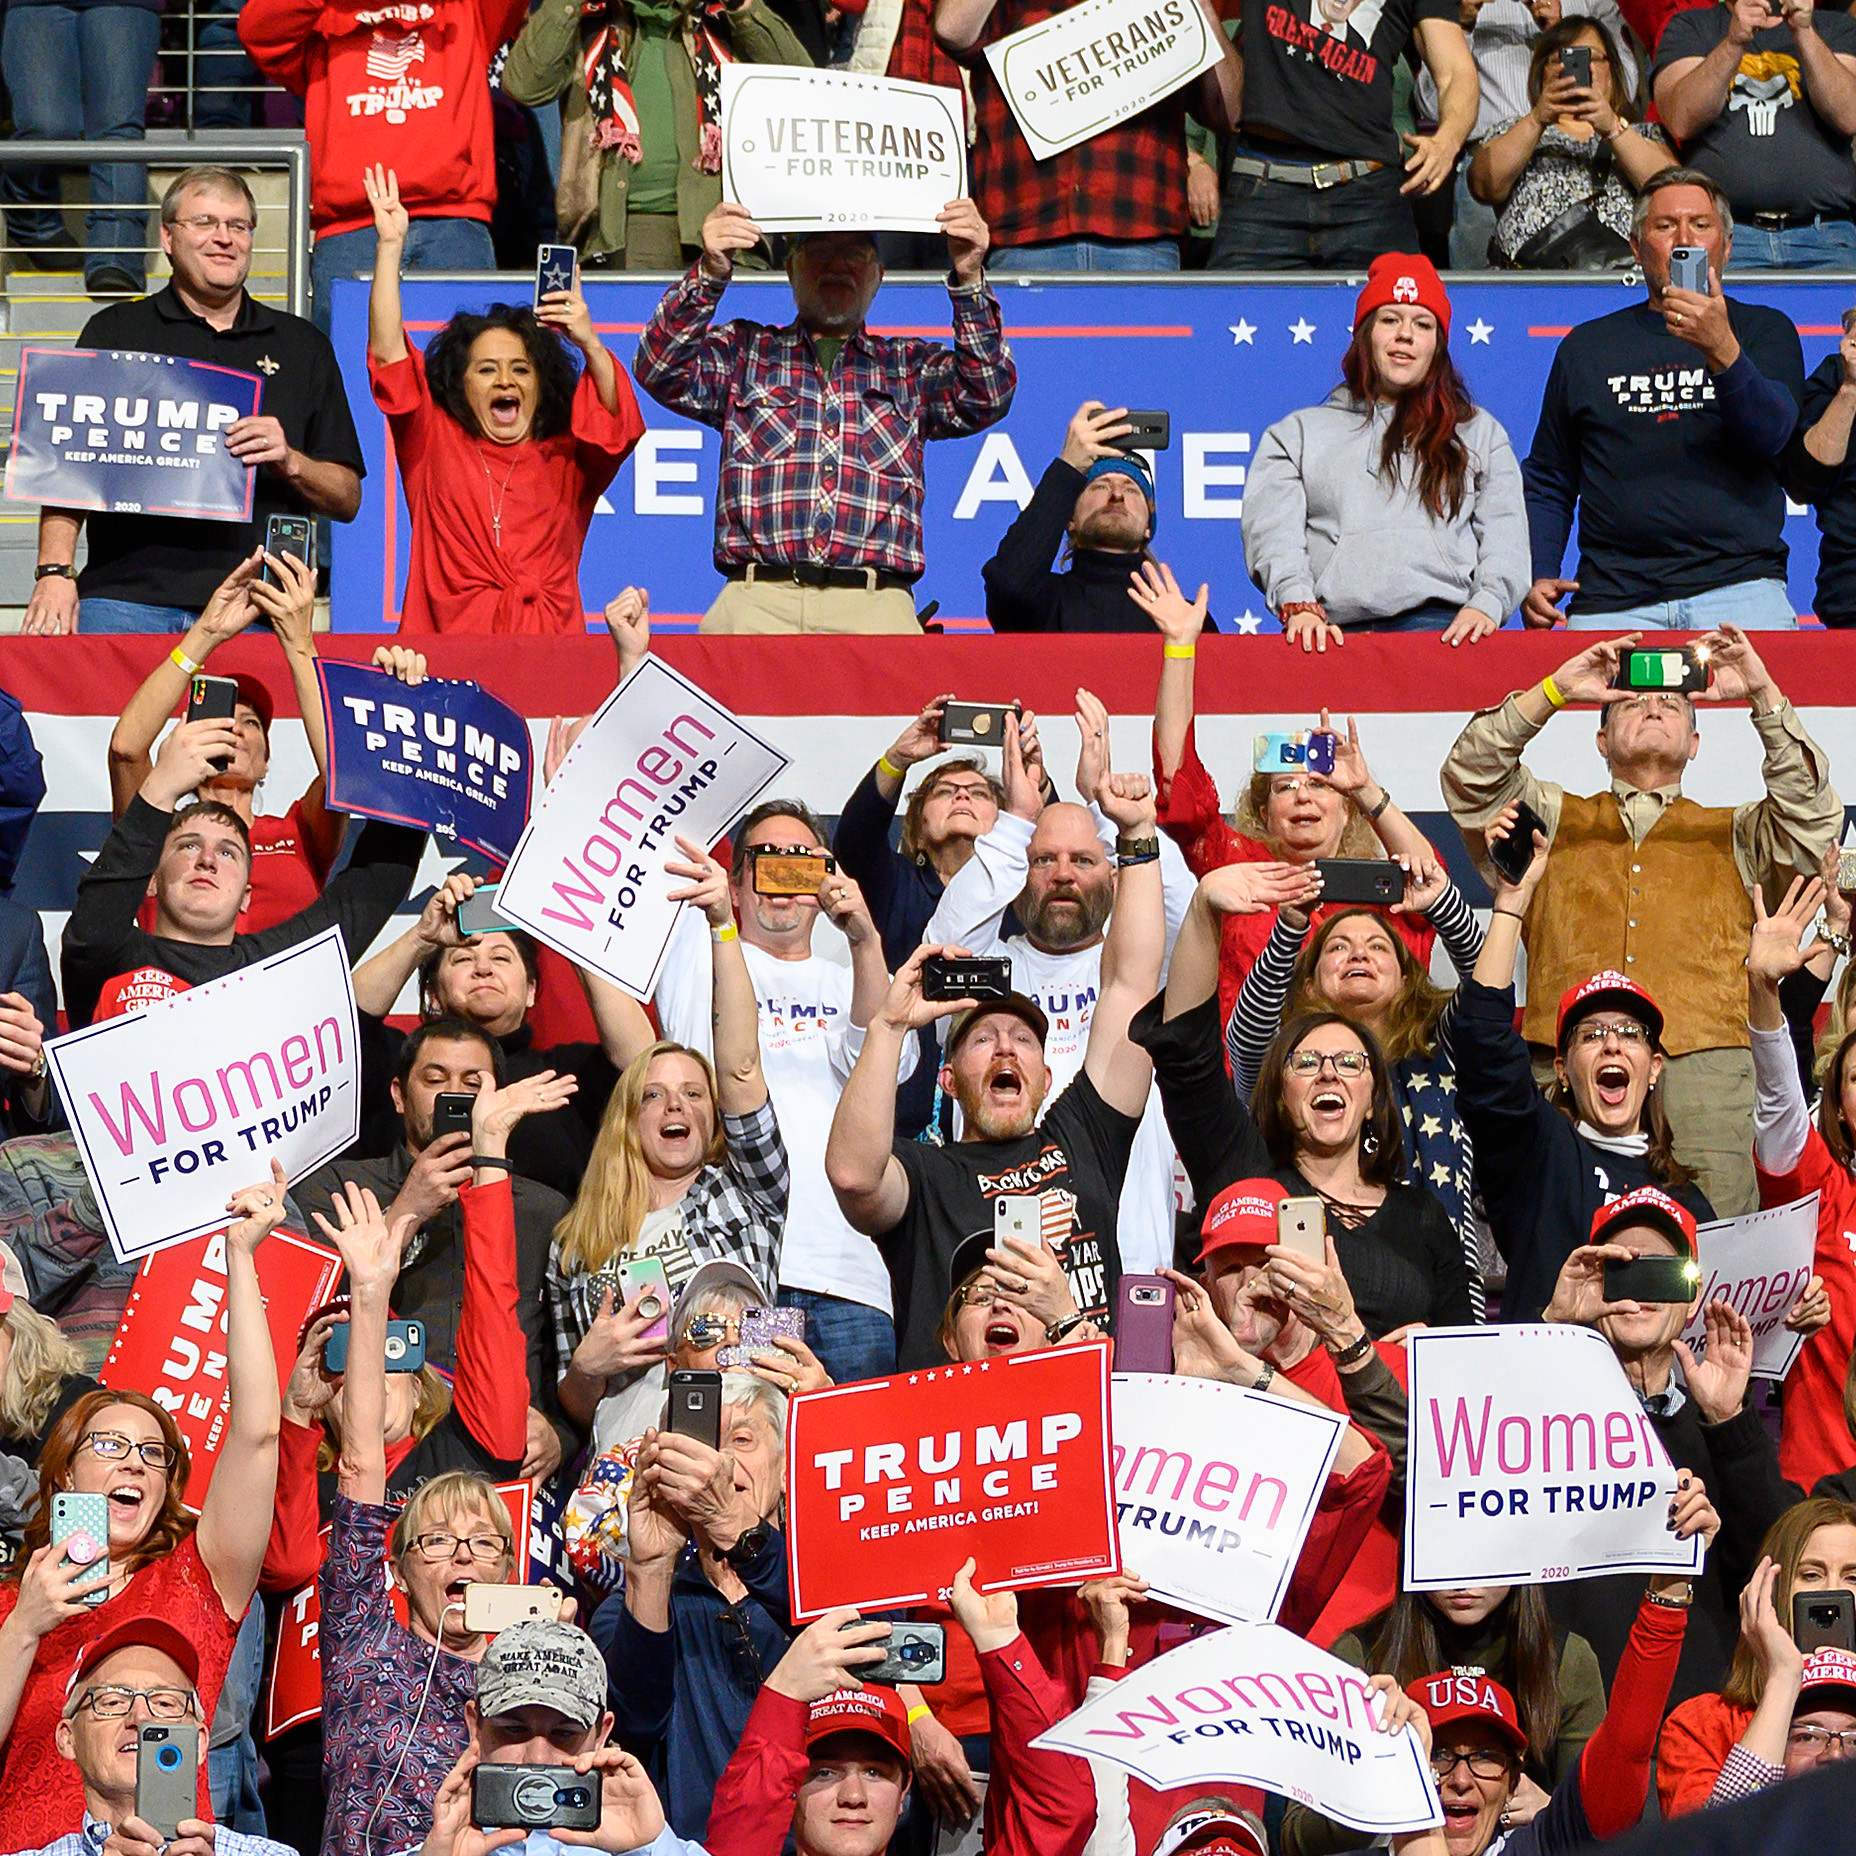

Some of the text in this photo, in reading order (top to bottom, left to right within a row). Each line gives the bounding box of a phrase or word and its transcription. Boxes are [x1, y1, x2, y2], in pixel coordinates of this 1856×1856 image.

[1036, 1, 1186, 92] VETERANS
[1266, 4, 1375, 85] GREAT AGAIN
[1063, 34, 1178, 104] FOR TRUMP
[347, 85, 444, 117] TRUMP
[1113, 95, 1148, 120] 2020
[767, 119, 944, 164] VETERANS
[787, 157, 929, 181] FOR TRUMP
[827, 212, 868, 224] 2020
[35, 391, 239, 431] TRUMP
[51, 426, 211, 455] PENCE
[64, 451, 201, 472] KEEP AMERICA GREAT!
[114, 501, 142, 514] 2020
[345, 696, 520, 775] TRUMP
[367, 732, 507, 798] PENCE
[382, 760, 498, 810] KEEP AMERICA GREAT!
[542, 712, 716, 934] Women
[607, 757, 721, 932] FOR TRUMP
[88, 1013, 346, 1157] Women
[147, 1084, 334, 1184] FOR TRUMP
[813, 1411, 1082, 1491] TRUMP
[838, 1463, 1058, 1523] PENCE
[1457, 1482, 1658, 1517] FOR TRUMP
[860, 1500, 1039, 1541] KEEP AMERICA GREAT!
[1540, 1567, 1570, 1579] 2020
[501, 1650, 583, 1669] MAKE AMERICA
[503, 1661, 580, 1678] GREAT AGAIN
[1087, 1666, 1377, 1741] Women
[1428, 1676, 1504, 1717] USA
[1166, 1715, 1363, 1767] FOR TRUMP
